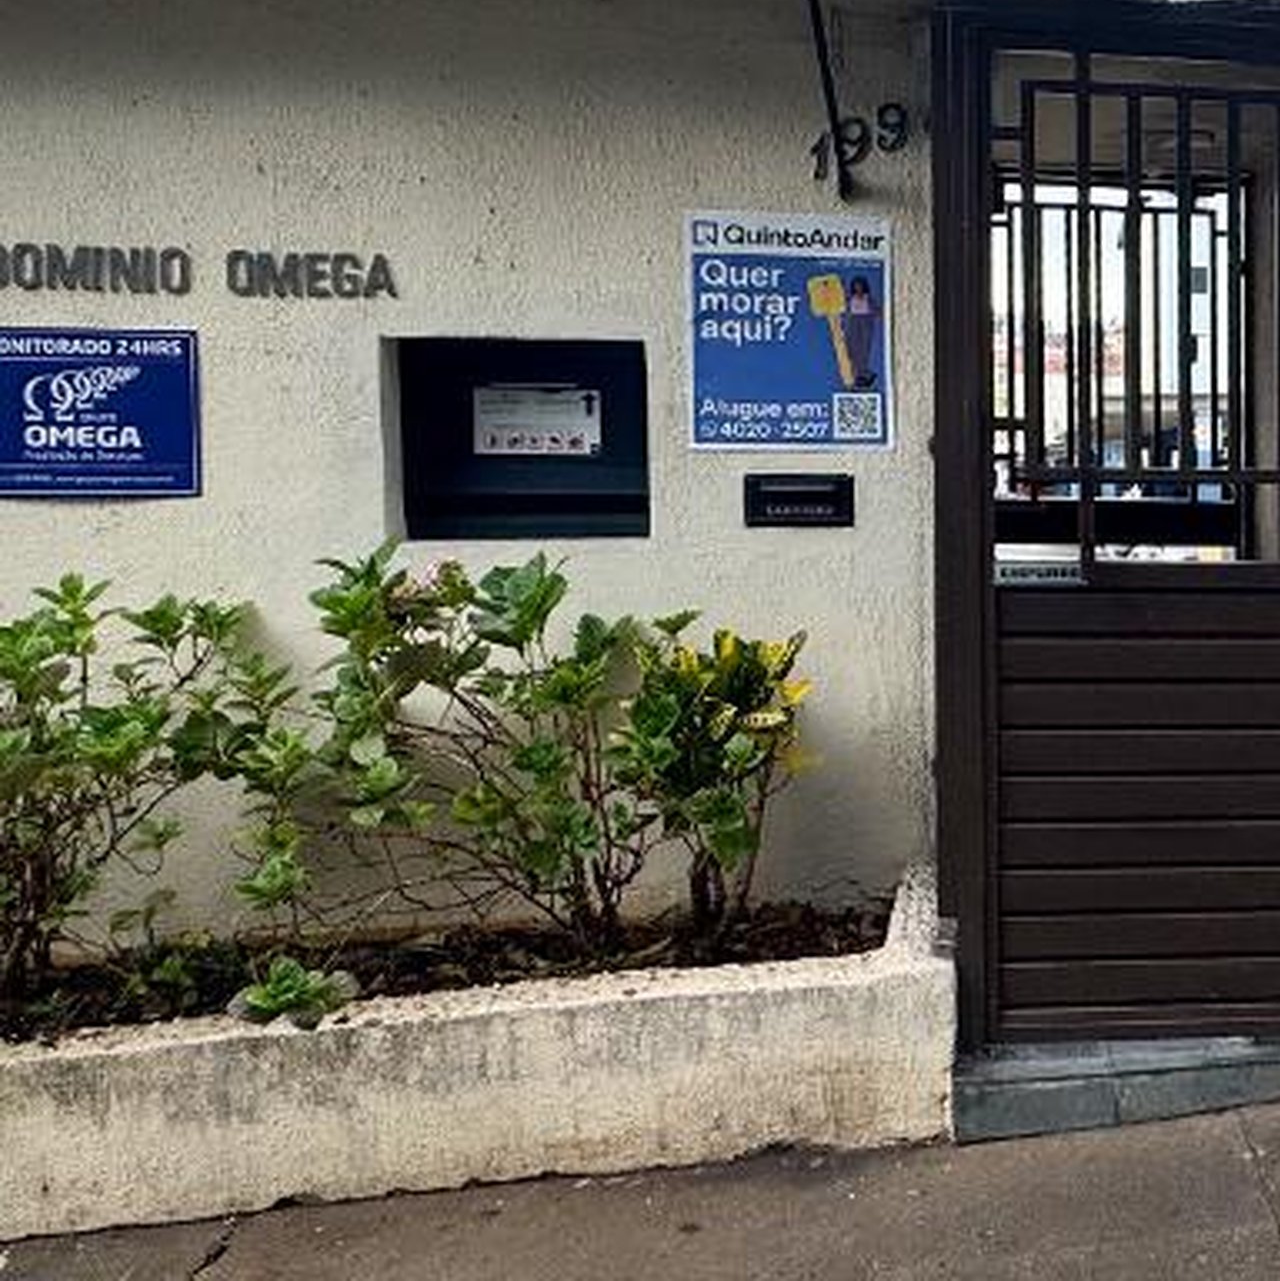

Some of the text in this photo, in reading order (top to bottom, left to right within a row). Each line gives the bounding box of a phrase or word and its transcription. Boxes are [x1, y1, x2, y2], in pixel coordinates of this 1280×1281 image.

[723, 224, 884, 251] QuintoAndar
[226, 249, 399, 299] OMEGA
[700, 259, 785, 288] Quer
[700, 292, 800, 315] morar
[700, 316, 793, 348] aqui?
[116, 339, 182, 355] 24HRS
[700, 399, 830, 421] Alugue em:
[24, 425, 143, 448] OMEGA
